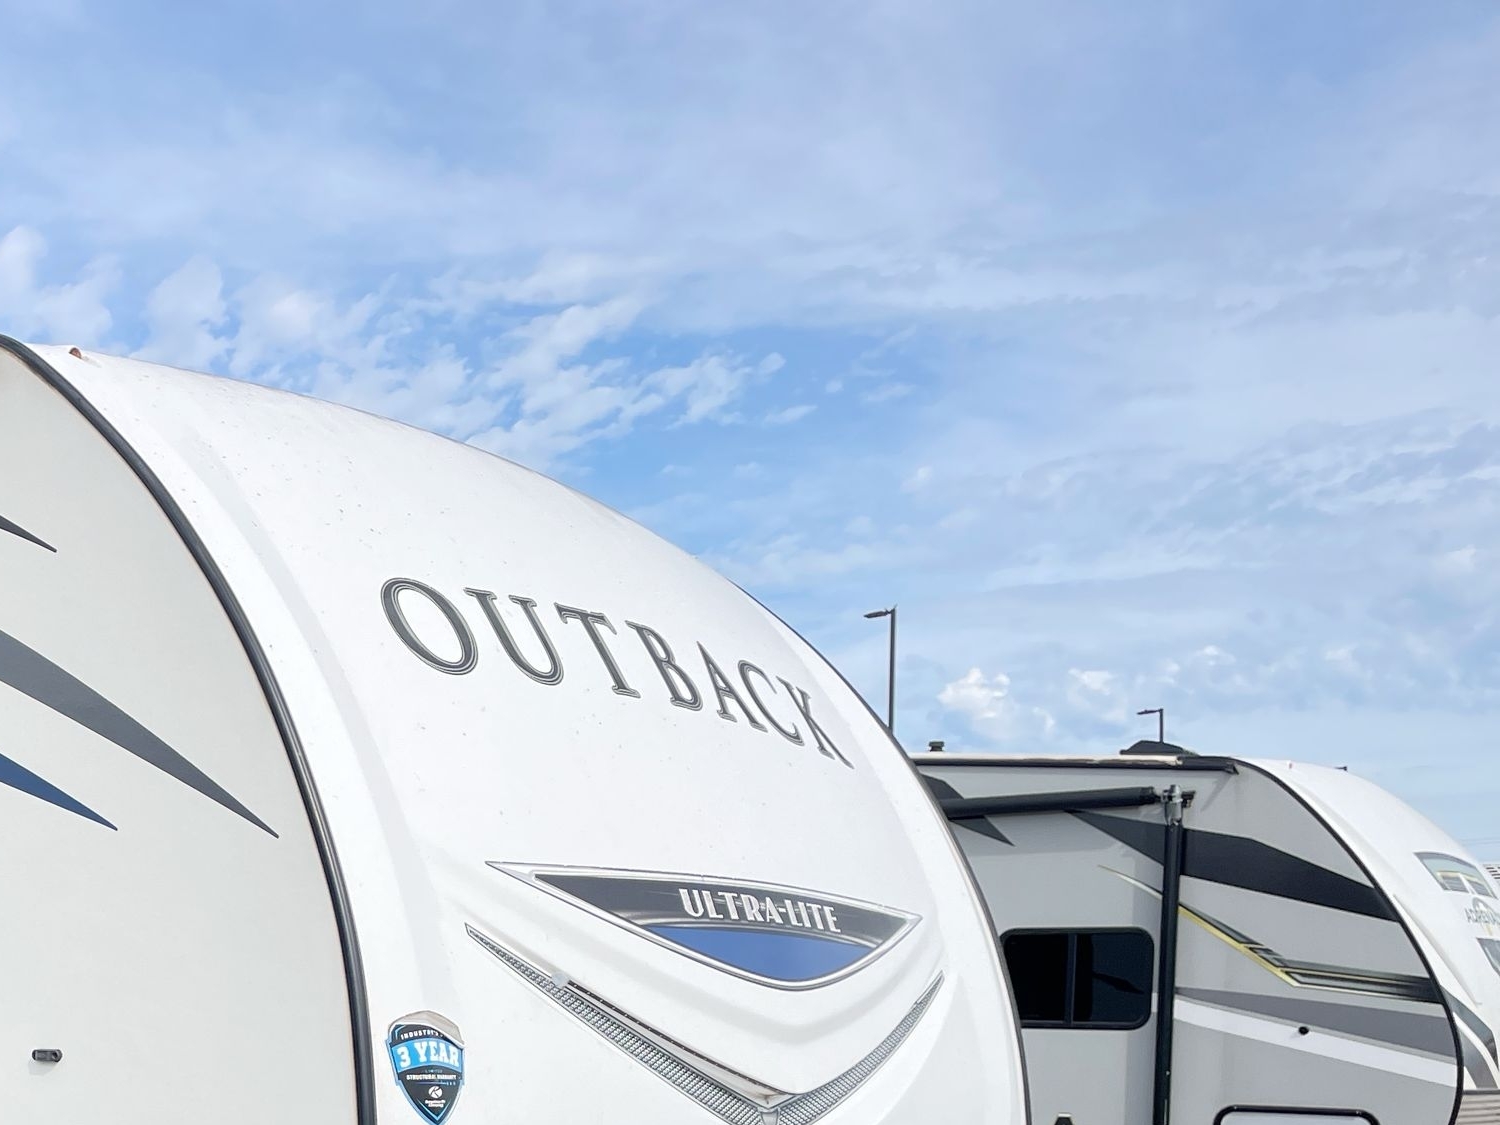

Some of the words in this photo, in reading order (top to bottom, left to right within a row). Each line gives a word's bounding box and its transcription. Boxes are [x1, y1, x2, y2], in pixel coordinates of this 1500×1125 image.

[381, 577, 854, 770] OUTBACK
[678, 888, 843, 934] ULTRA-LITE
[397, 1045, 411, 1068] 3
[414, 1041, 460, 1067] YEAR
